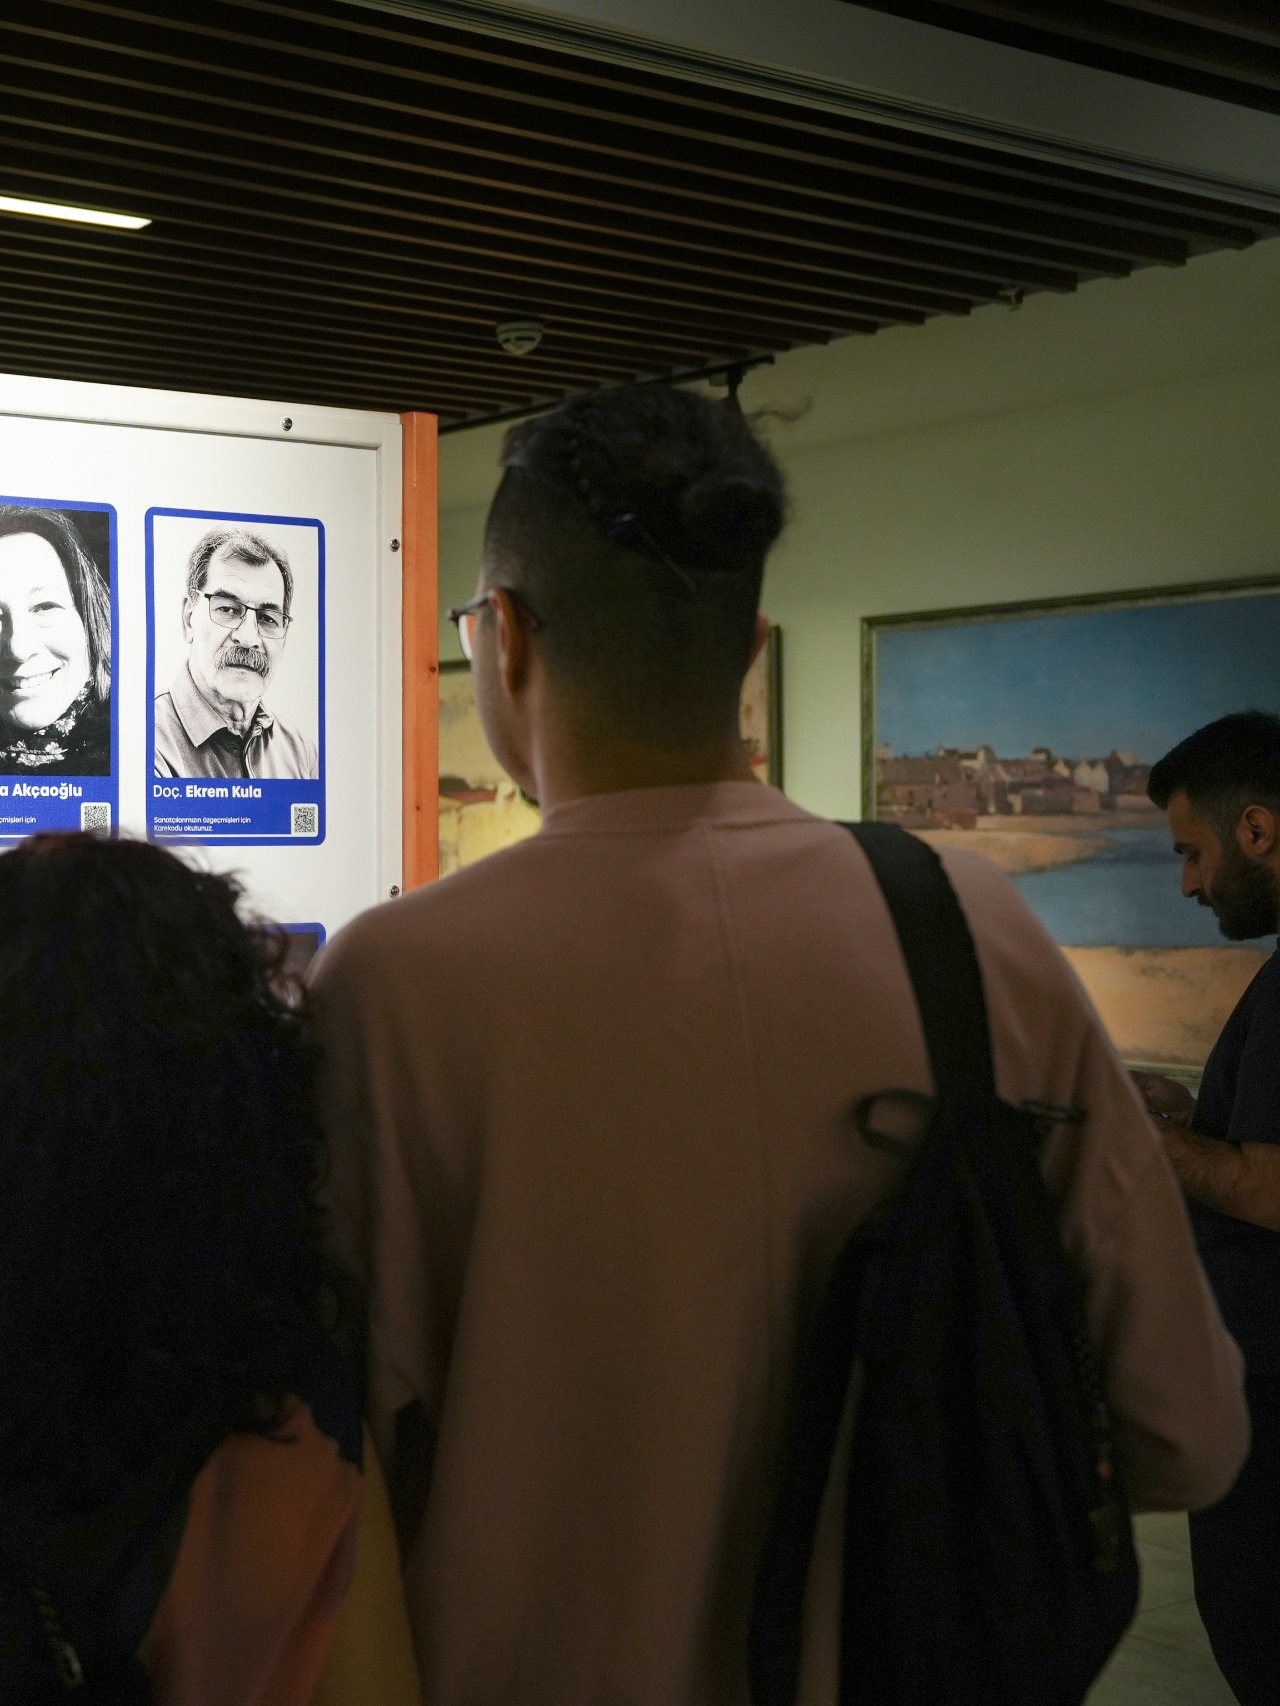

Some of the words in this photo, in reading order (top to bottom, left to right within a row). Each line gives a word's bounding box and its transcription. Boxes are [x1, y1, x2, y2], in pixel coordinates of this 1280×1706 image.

[12, 783, 83, 800] Akçaoğlu
[153, 785, 183, 800] Doç.
[185, 785, 229, 798] Ekrem
[232, 785, 262, 799] Kula
